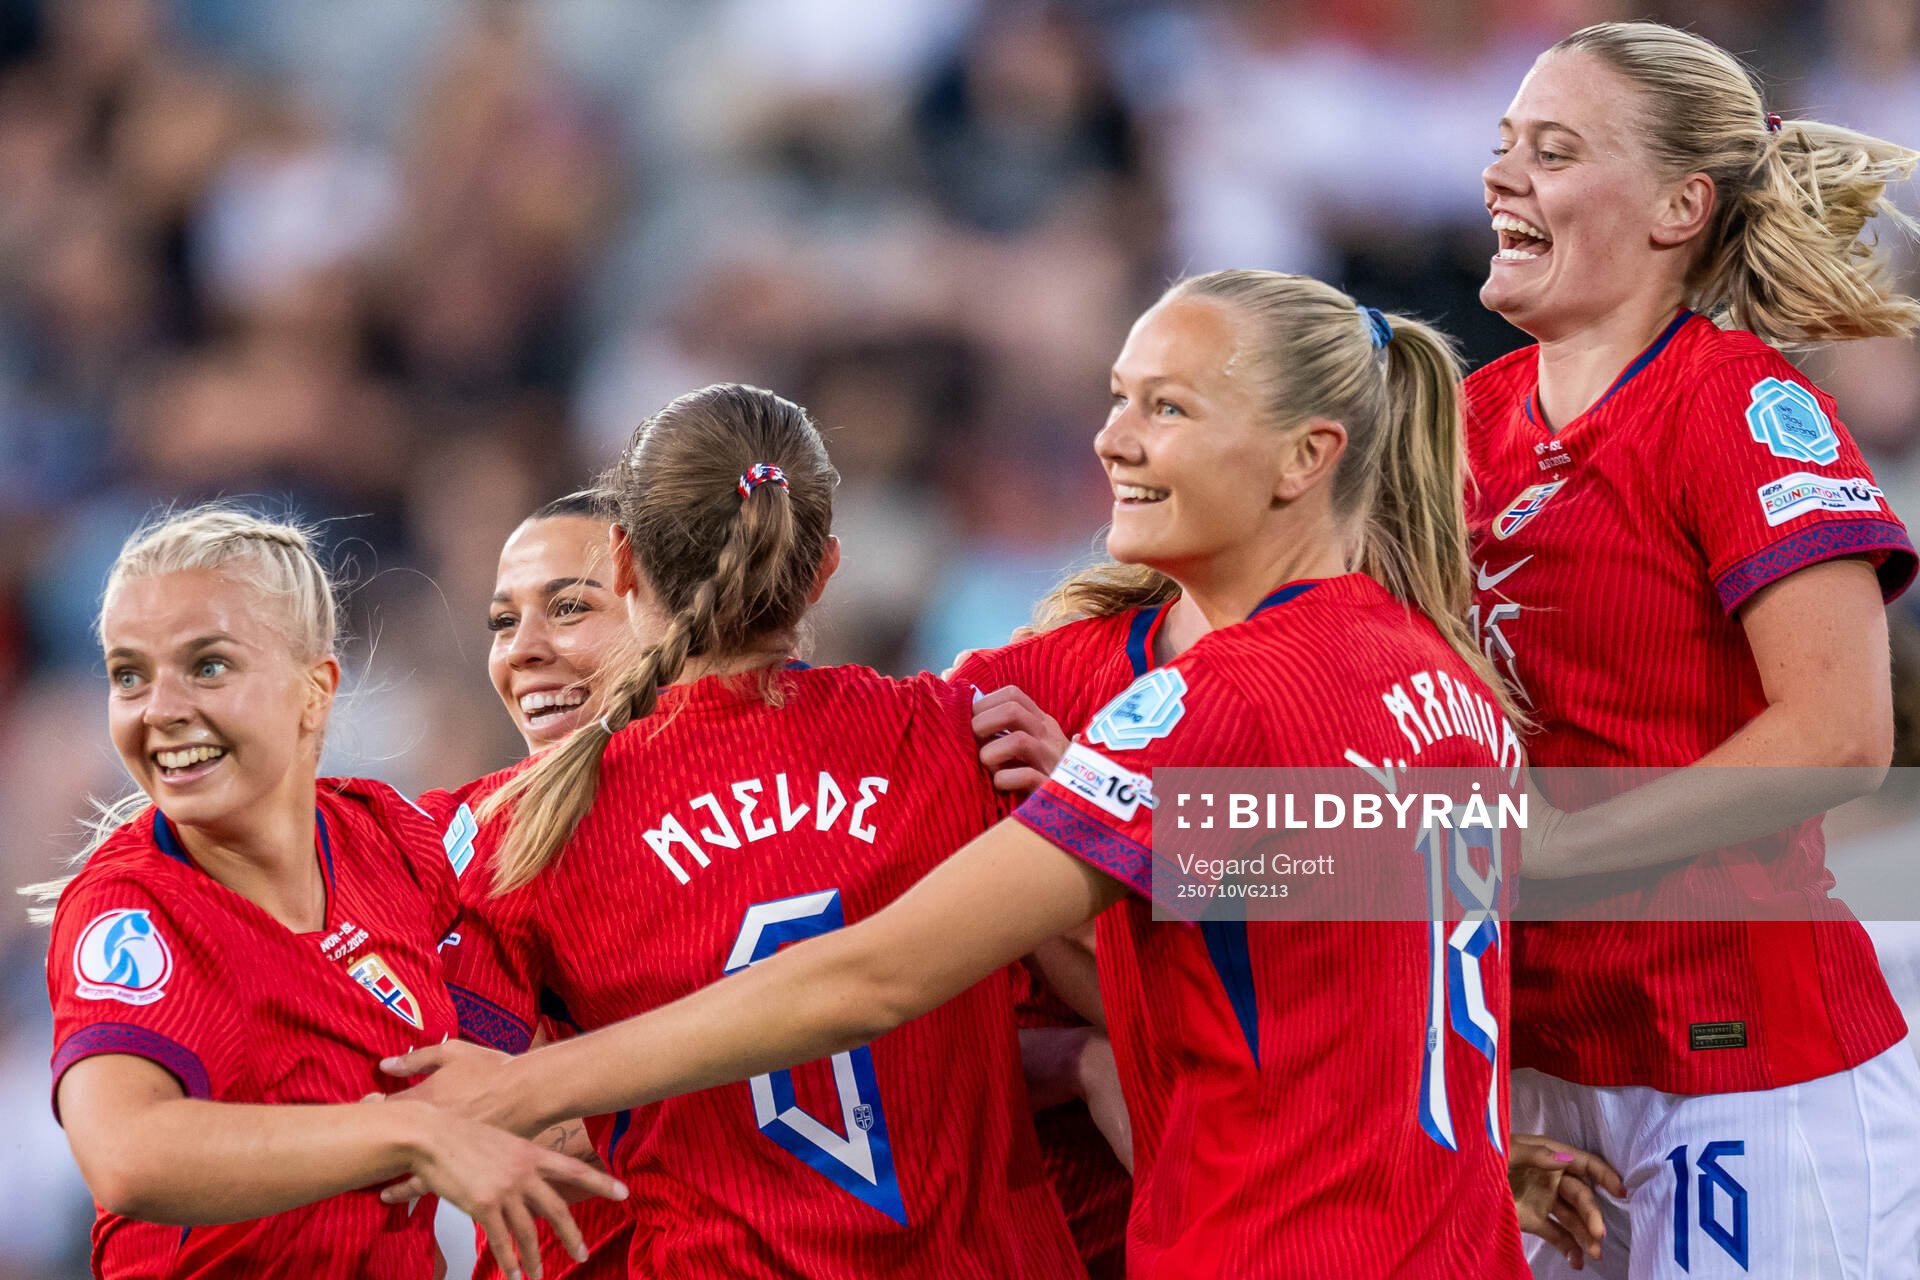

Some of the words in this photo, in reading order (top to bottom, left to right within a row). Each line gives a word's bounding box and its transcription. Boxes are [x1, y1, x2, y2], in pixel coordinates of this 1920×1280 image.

[1765, 486, 1842, 512] FOUNDATION
[641, 770, 890, 886] MJELDE
[1665, 1140, 1749, 1275] 16
